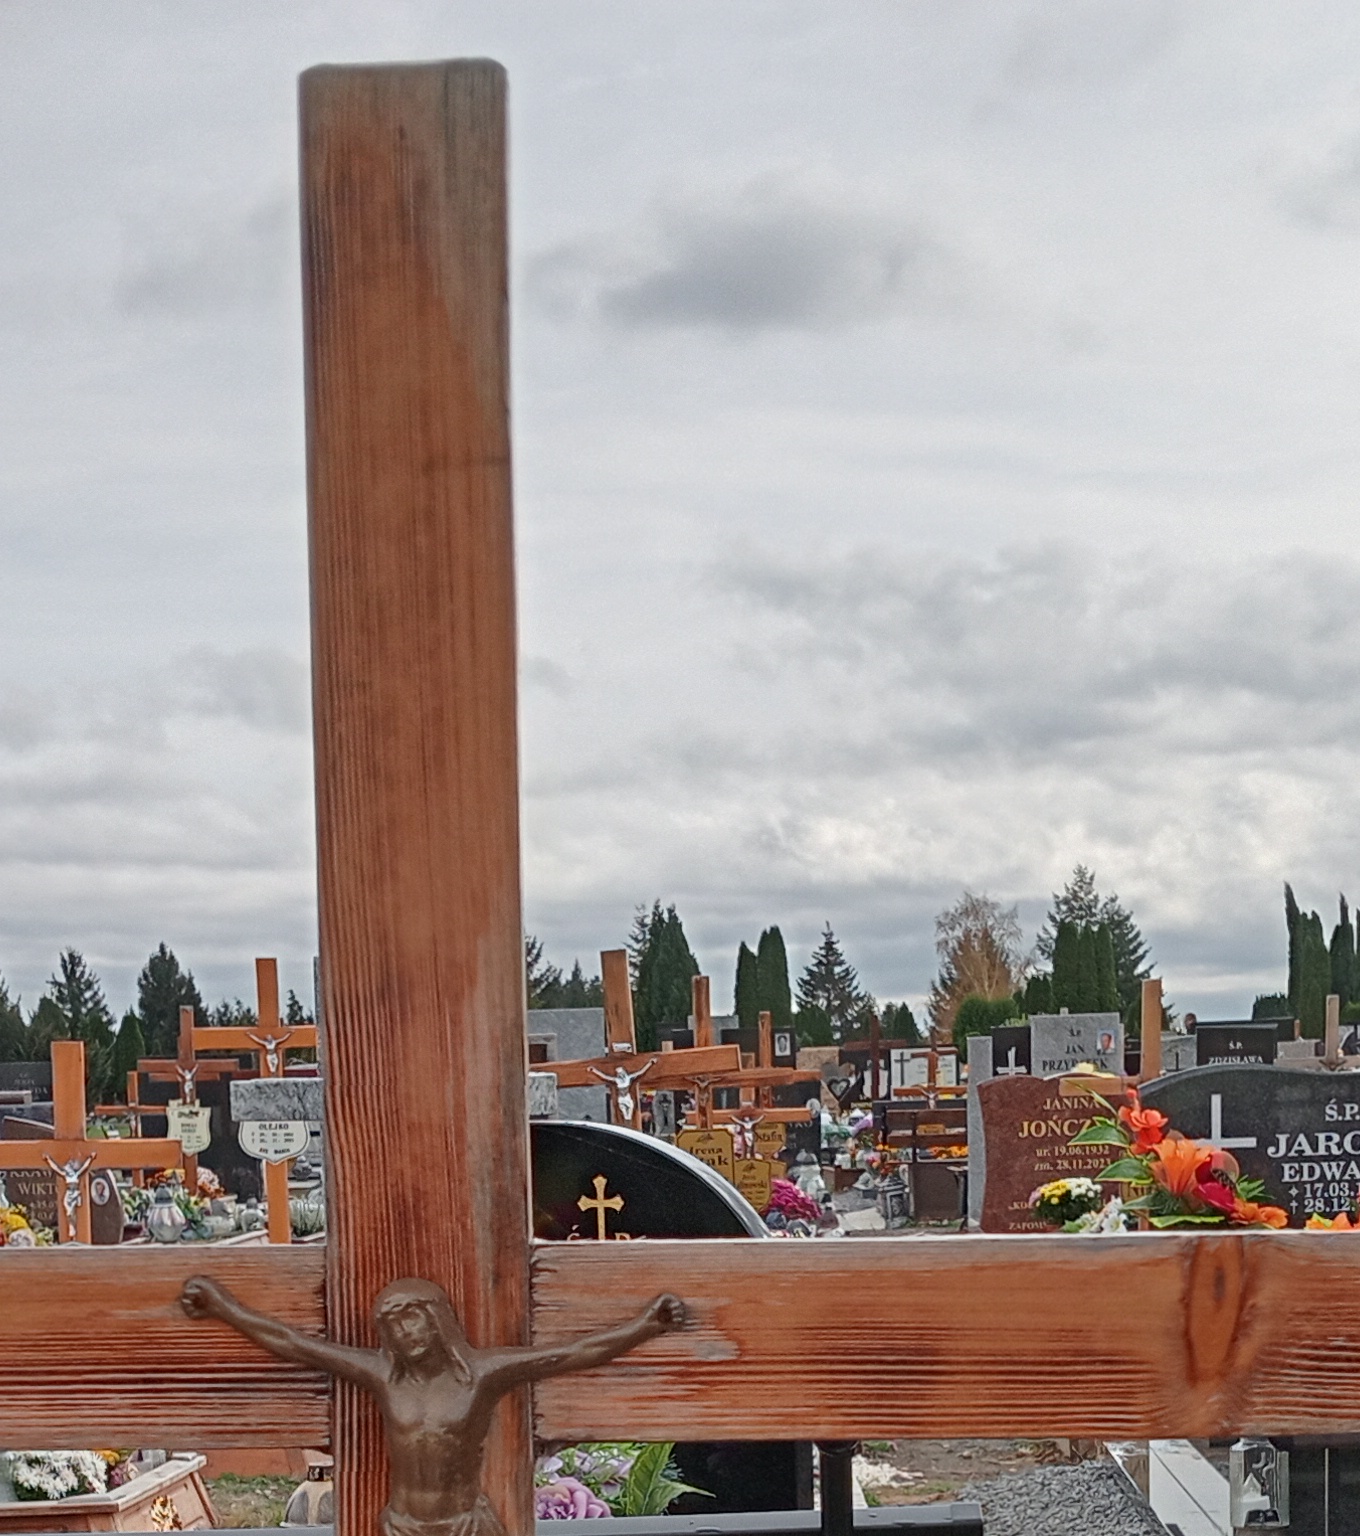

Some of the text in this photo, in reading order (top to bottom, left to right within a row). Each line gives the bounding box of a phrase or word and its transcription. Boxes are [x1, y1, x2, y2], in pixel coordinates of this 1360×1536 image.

[1065, 1044, 1086, 1056] JAN
[1042, 1095, 1100, 1111] JANINA
[1324, 1098, 1360, 1122] Ś.P.
[1018, 1114, 1092, 1139] JOŃCZ
[1035, 1144, 1110, 1157] ur. 19.06.1932
[17, 1181, 58, 1196] WIKT
